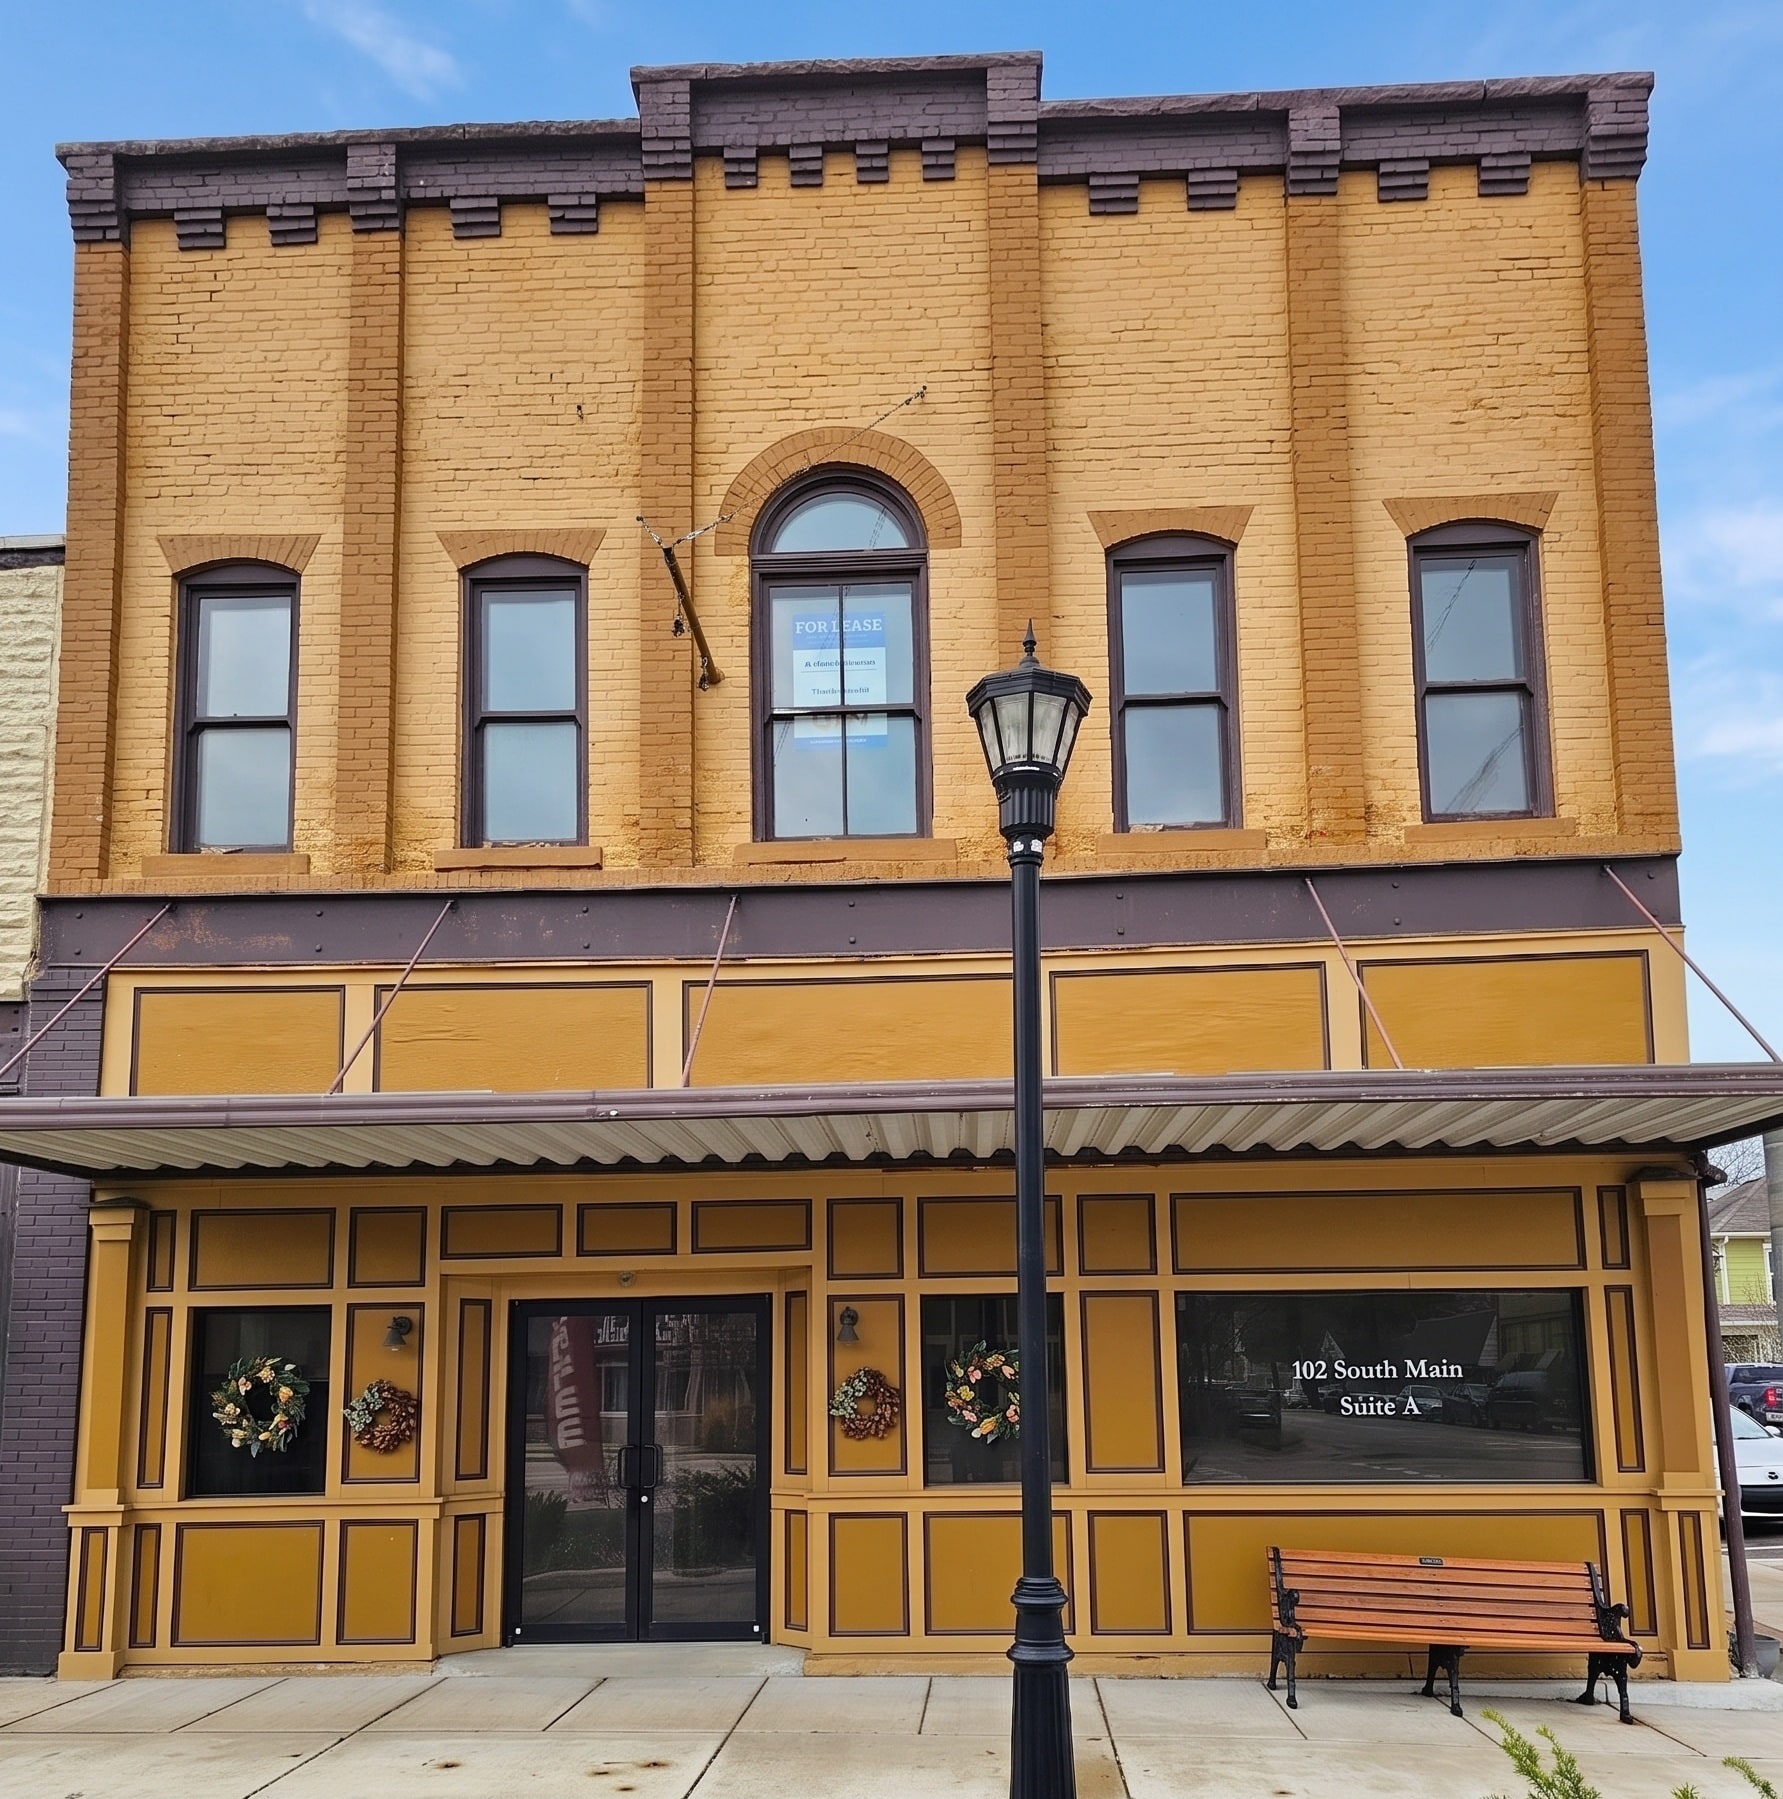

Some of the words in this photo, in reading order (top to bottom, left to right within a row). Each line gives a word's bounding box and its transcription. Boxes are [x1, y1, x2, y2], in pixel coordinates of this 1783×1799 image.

[795, 621, 828, 634] FOR
[831, 618, 882, 633] LEASE
[1292, 1360, 1328, 1380] 102
[1334, 1360, 1399, 1379] South
[1404, 1359, 1463, 1379] Main
[1340, 1396, 1397, 1416] Suite
[1402, 1396, 1422, 1415] A
